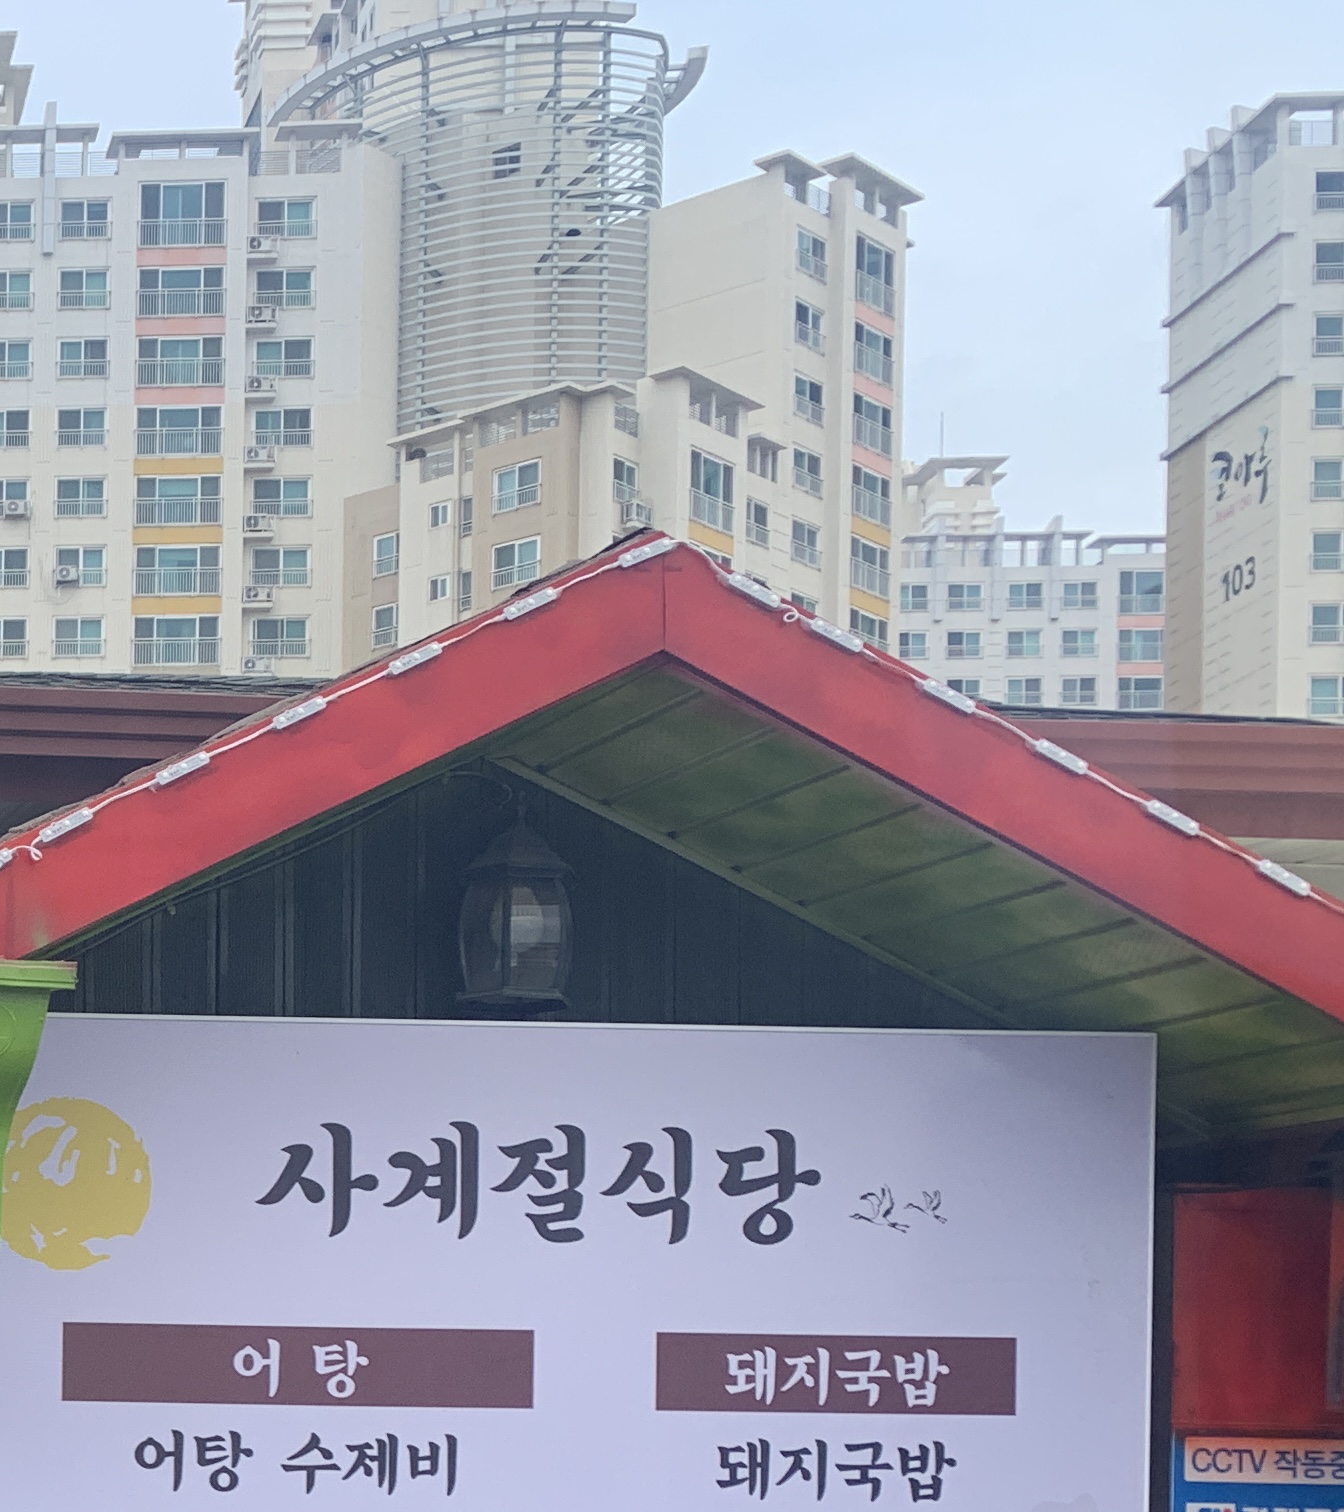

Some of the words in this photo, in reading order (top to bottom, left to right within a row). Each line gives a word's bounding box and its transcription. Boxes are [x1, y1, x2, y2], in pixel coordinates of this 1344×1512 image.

[1223, 556, 1256, 601] 103
[254, 1120, 822, 1246] 사계절식당
[724, 1346, 950, 1408] 돼지국밥
[134, 1429, 254, 1493] 어탕
[280, 1432, 458, 1497] 수제비
[715, 1438, 958, 1503] 돼지국밥
[1191, 1447, 1267, 1474] CCTV
